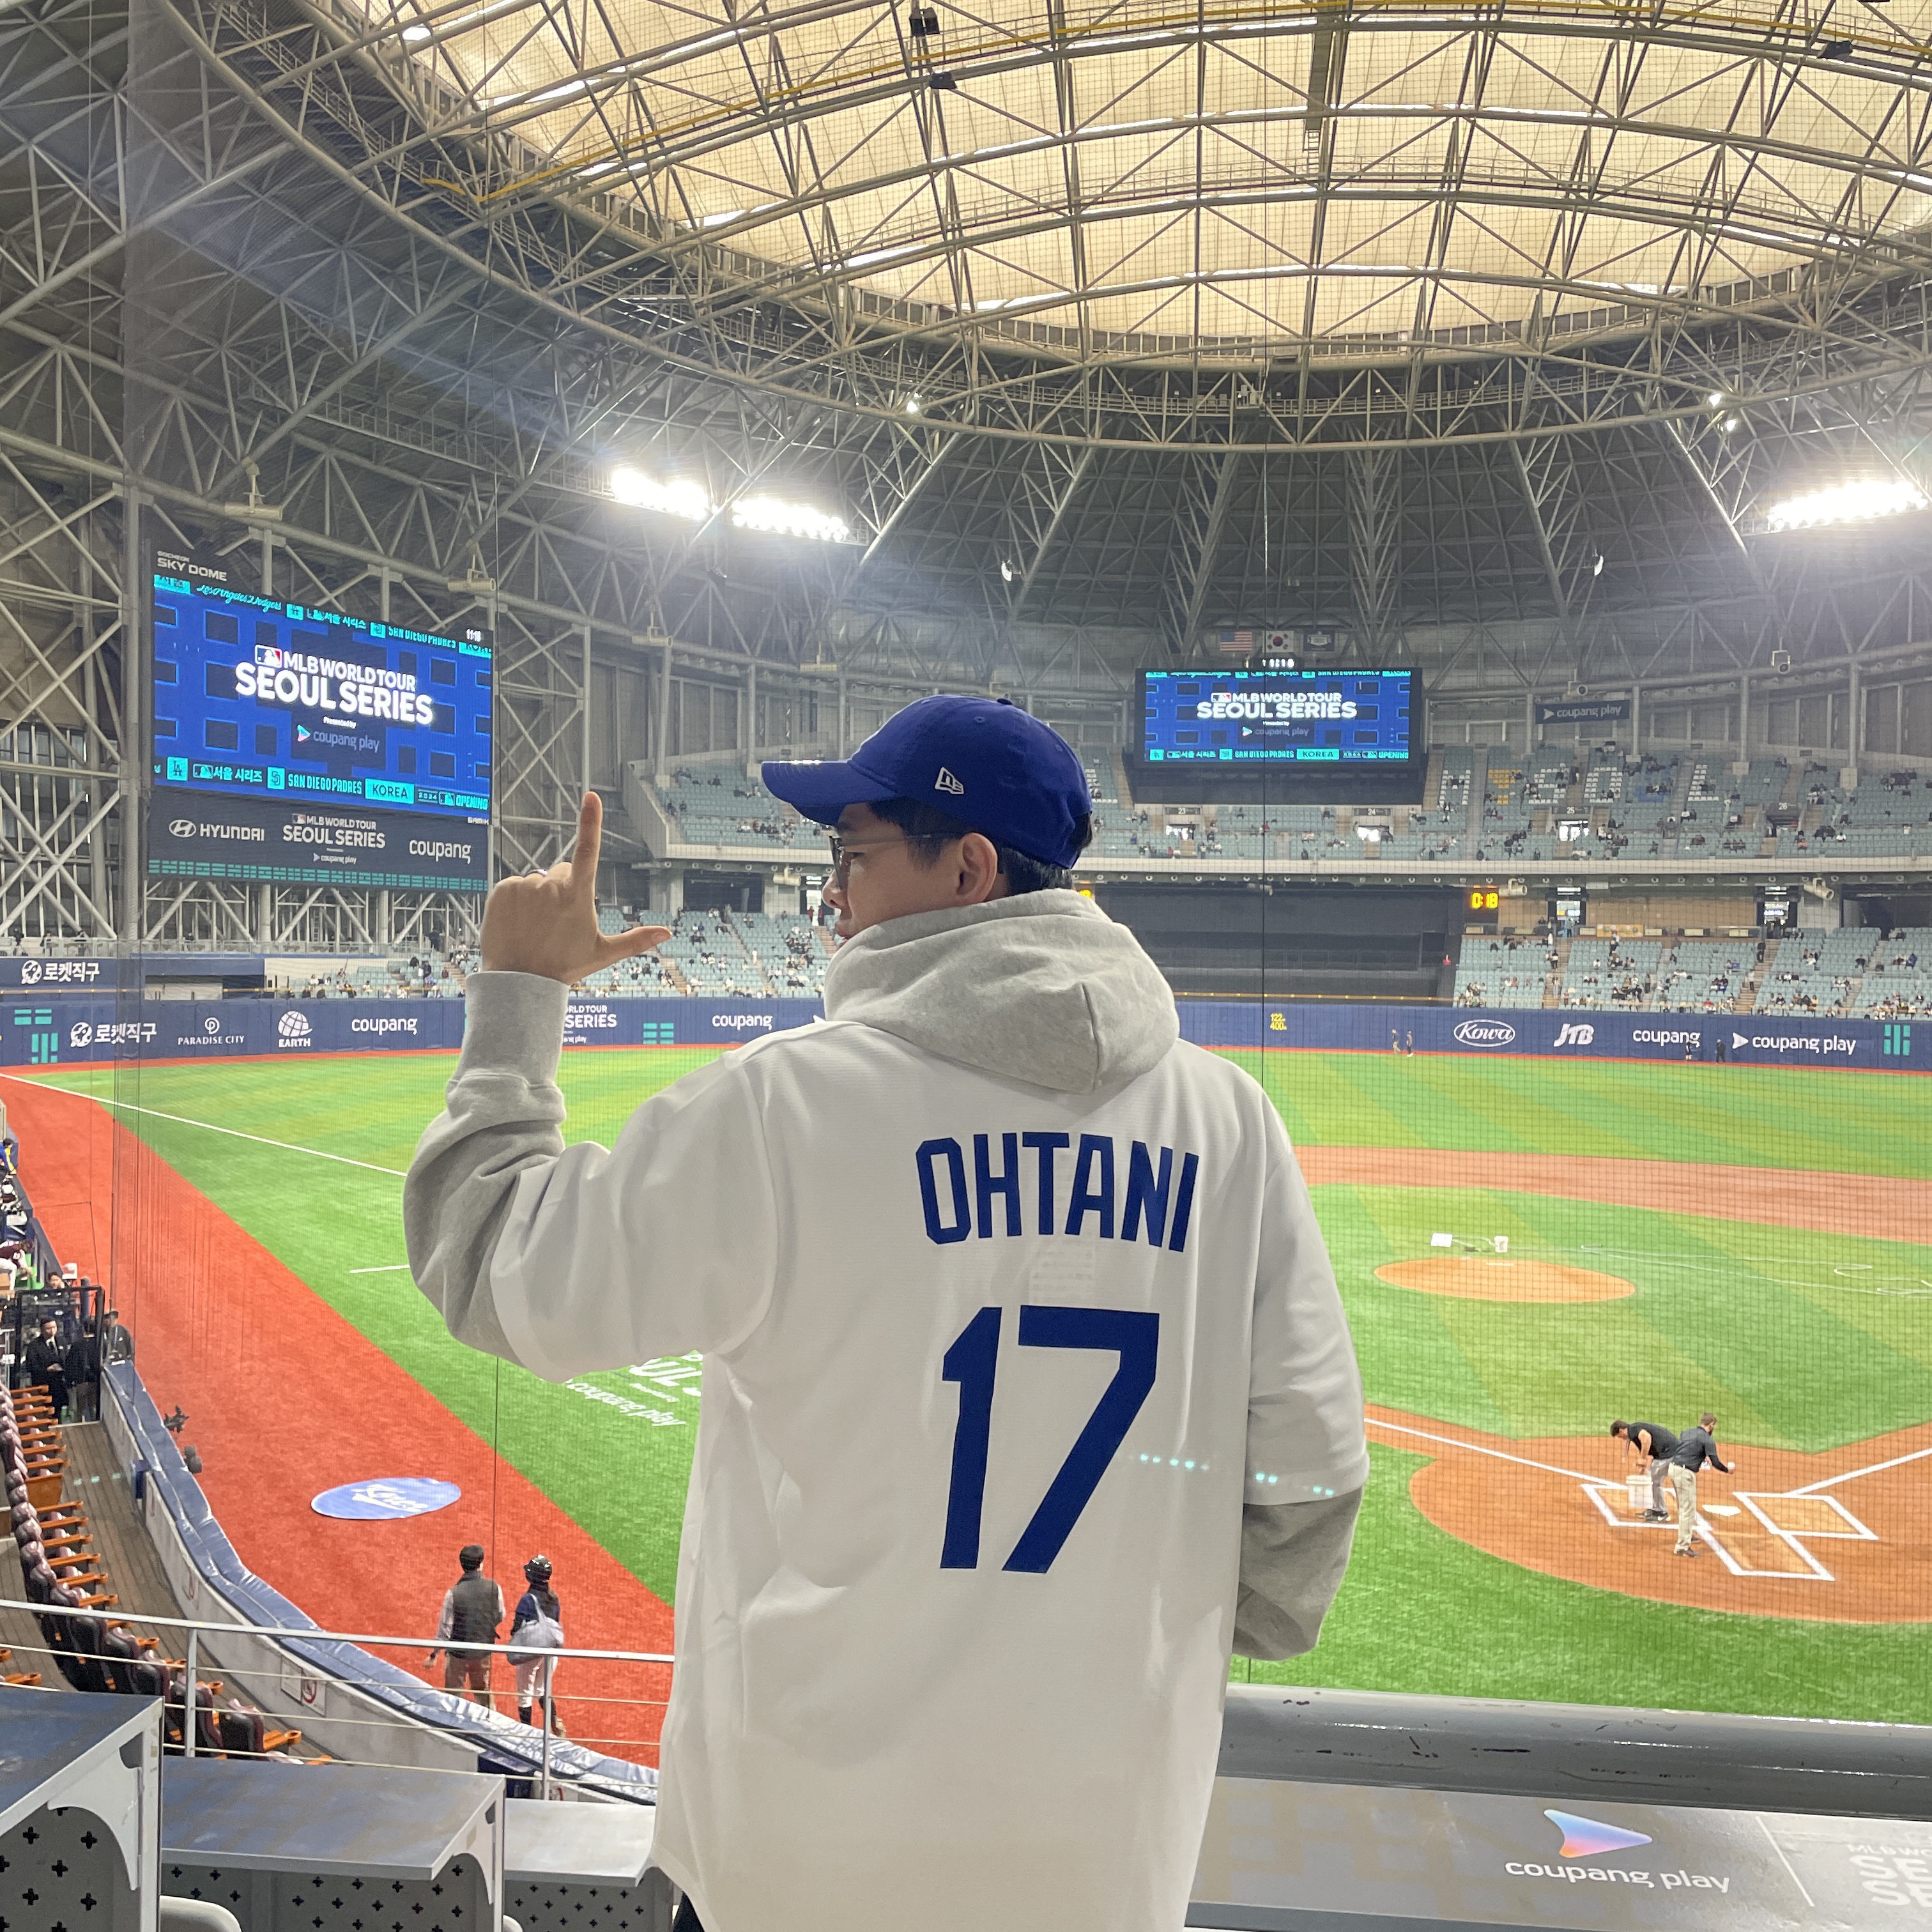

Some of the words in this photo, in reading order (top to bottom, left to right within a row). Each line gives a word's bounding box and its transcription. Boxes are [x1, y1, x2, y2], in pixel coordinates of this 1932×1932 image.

[157, 557, 186, 571] SKY
[188, 564, 227, 581] DOME
[284, 650, 319, 675] MLB
[319, 657, 377, 685] WORLD
[376, 668, 417, 692] TOUR
[235, 662, 337, 710] SEOUL
[339, 680, 434, 726] SERIES
[1232, 693, 1259, 702] MLB
[1259, 693, 1308, 702] WORLD
[1308, 693, 1342, 702] TOUR
[1197, 702, 1274, 719] SEOUL
[1275, 702, 1358, 719] SERIES
[1557, 707, 1598, 719] coupang
[1600, 703, 1621, 717] play
[1255, 728, 1290, 737] coupang
[1291, 727, 1309, 737] play
[313, 730, 357, 751] coupang
[358, 735, 379, 754] play
[213, 766, 233, 781] 서울
[235, 769, 263, 783] 시리즈
[288, 774, 305, 788] SAN
[307, 776, 332, 792] DIEGO
[332, 778, 362, 795] PADRES
[372, 784, 409, 799] KOREA
[456, 794, 489, 810] OPENING
[1567, 806, 1575, 815] 25
[1779, 802, 1788, 811] 26
[1368, 808, 1376, 816] 24
[307, 815, 325, 826] MLB
[325, 817, 355, 829] WORLD
[355, 820, 376, 830] TOUR
[200, 823, 264, 841] HYUNDAI
[282, 824, 334, 845] SEOUL
[335, 829, 385, 848] SERIES
[409, 839, 471, 864] coupang
[43, 962, 100, 983] 로켓직구
[567, 1005, 585, 1013] RLD
[585, 1004, 608, 1013] TOUR
[351, 1018, 418, 1035] coupang
[565, 1013, 617, 1029] SERIES
[712, 1015, 773, 1031] coupang
[94, 1022, 158, 1044] 로켓직구
[178, 1036, 223, 1045] PARADISE
[225, 1035, 244, 1044] CITY
[575, 1035, 587, 1044] play
[1457, 1024, 1514, 1040] Kowa
[1554, 1023, 1595, 1047] JTB
[1632, 1029, 1701, 1048] coupang
[278, 1038, 311, 1048] EARTH
[1752, 1036, 1820, 1054] coupang
[1823, 1035, 1857, 1055] play
[916, 1131, 1200, 1253] OHTANI
[566, 1383, 647, 1413] coupang
[626, 1409, 687, 1427] play
[940, 1305, 1160, 1574] 17
[1505, 1862, 1655, 1889] coupang
[1660, 1869, 1730, 1893] play
